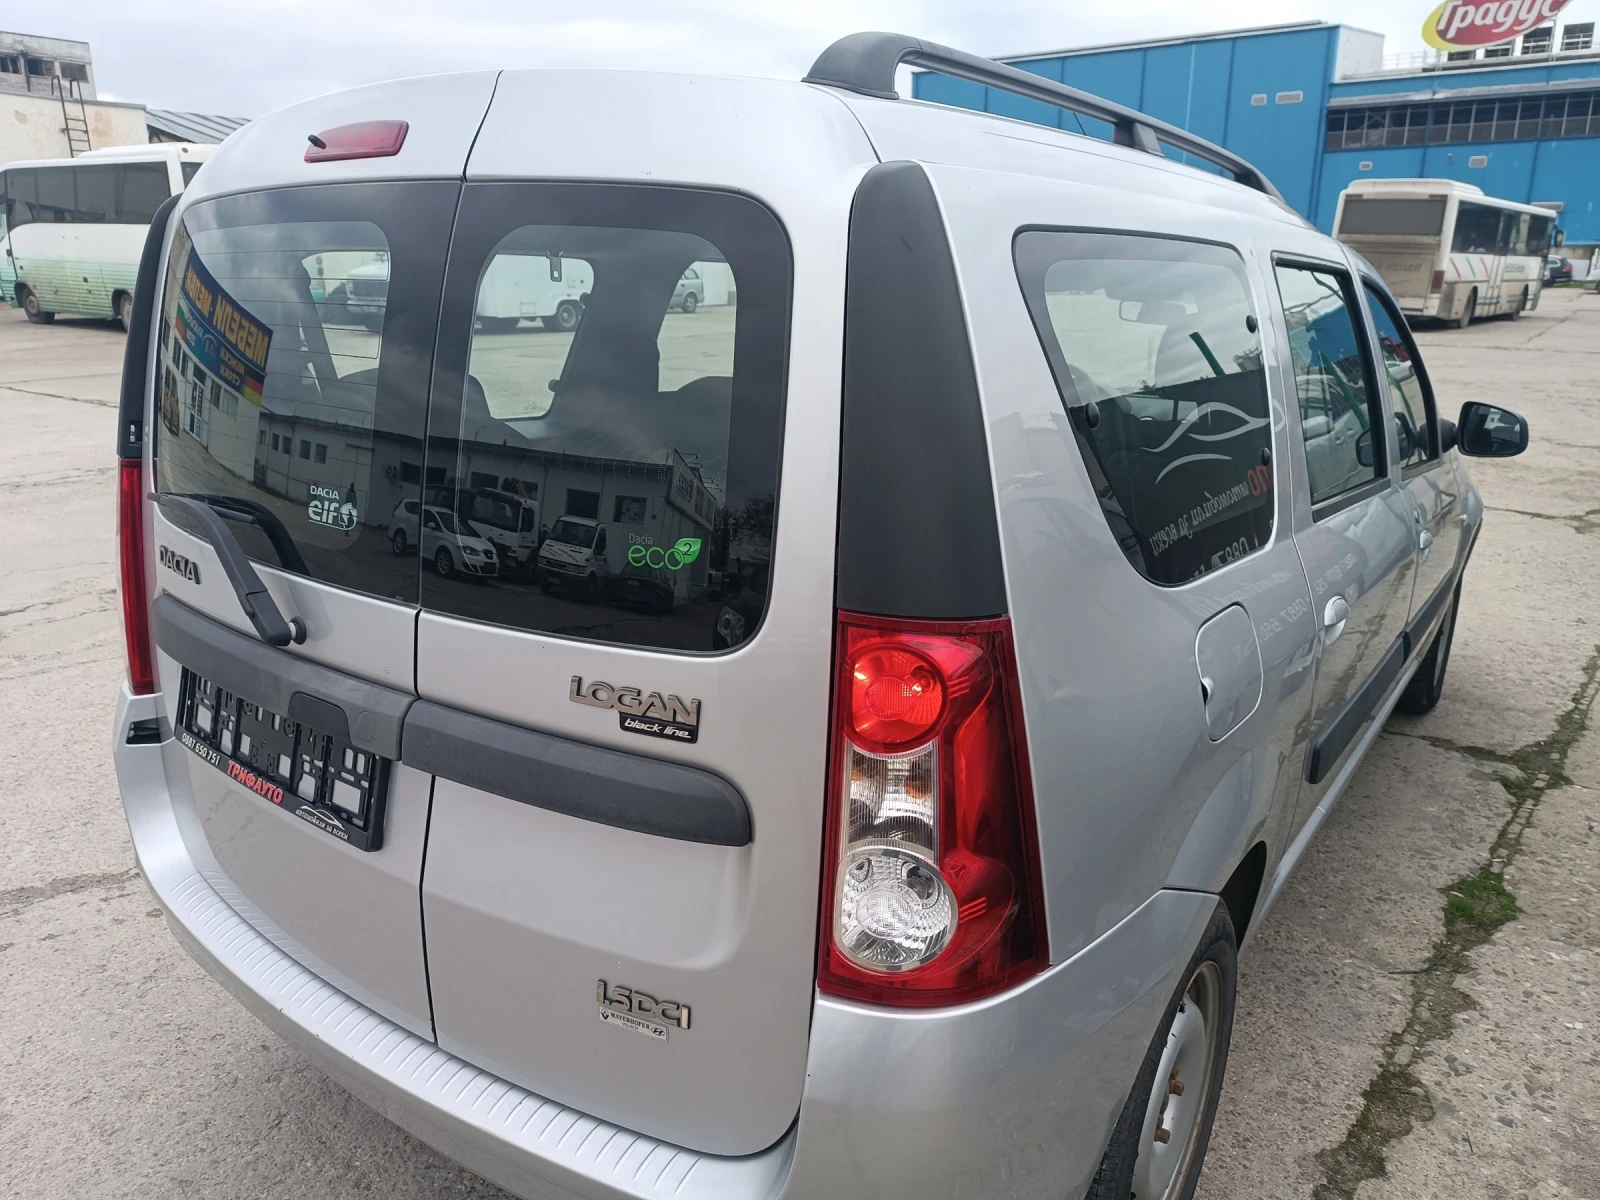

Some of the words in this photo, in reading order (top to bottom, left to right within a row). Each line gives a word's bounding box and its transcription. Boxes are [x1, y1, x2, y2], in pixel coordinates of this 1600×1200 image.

[310, 485, 340, 500] DACIA
[308, 500, 338, 523] elf
[628, 533, 654, 545] Dacia
[159, 544, 202, 584] DACIA
[569, 675, 701, 726] LOGAN
[624, 718, 663, 735] black
[663, 724, 692, 739] line
[181, 732, 195, 748] 0887
[195, 743, 207, 757] 650
[207, 750, 220, 766] 751
[610, 1011, 651, 1030] MAYERHOFER
